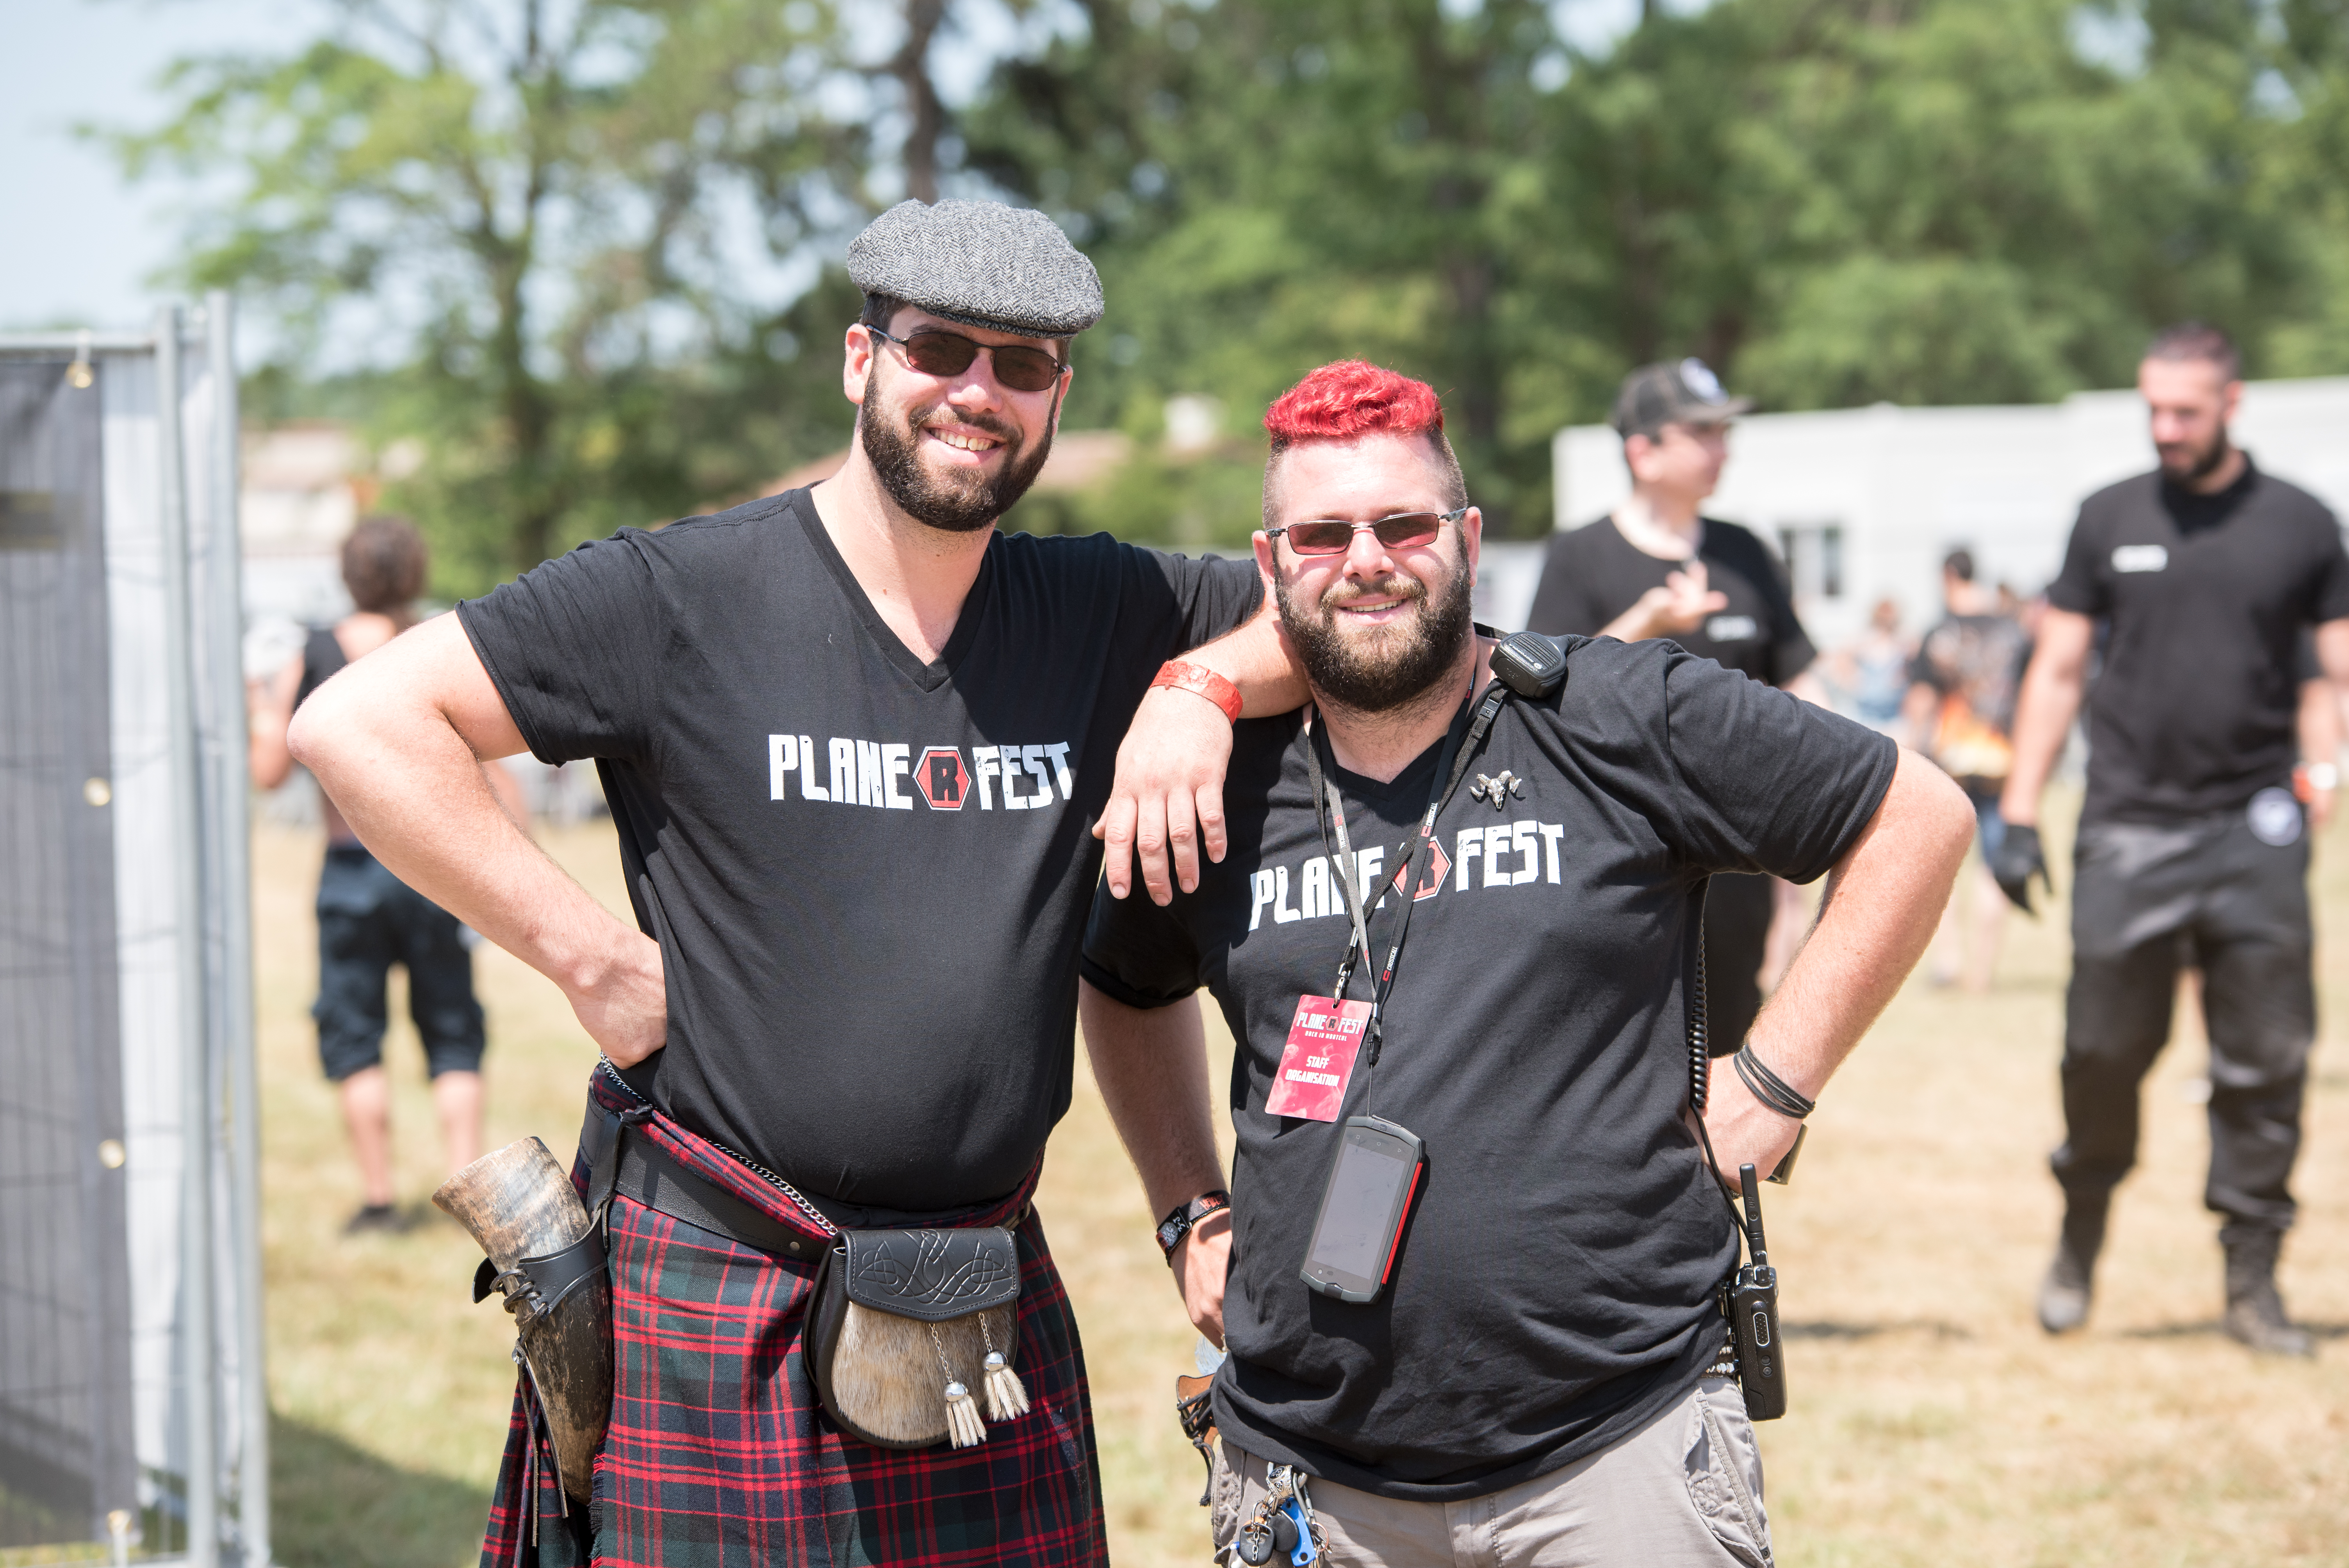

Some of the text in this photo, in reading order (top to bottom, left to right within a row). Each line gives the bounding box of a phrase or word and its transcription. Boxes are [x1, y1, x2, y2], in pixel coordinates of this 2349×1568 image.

[769, 734, 913, 811] PLANE
[972, 741, 1073, 811] FEST
[1426, 802, 1438, 827] CROSSCALL
[1456, 820, 1564, 892] FEST
[1387, 946, 1398, 971] CROSSCALL
[1296, 1012, 1328, 1030] PLANE
[1337, 1017, 1364, 1035] FEST
[1306, 1055, 1330, 1069] STAFF
[1285, 1069, 1340, 1087] ORGANISATION
